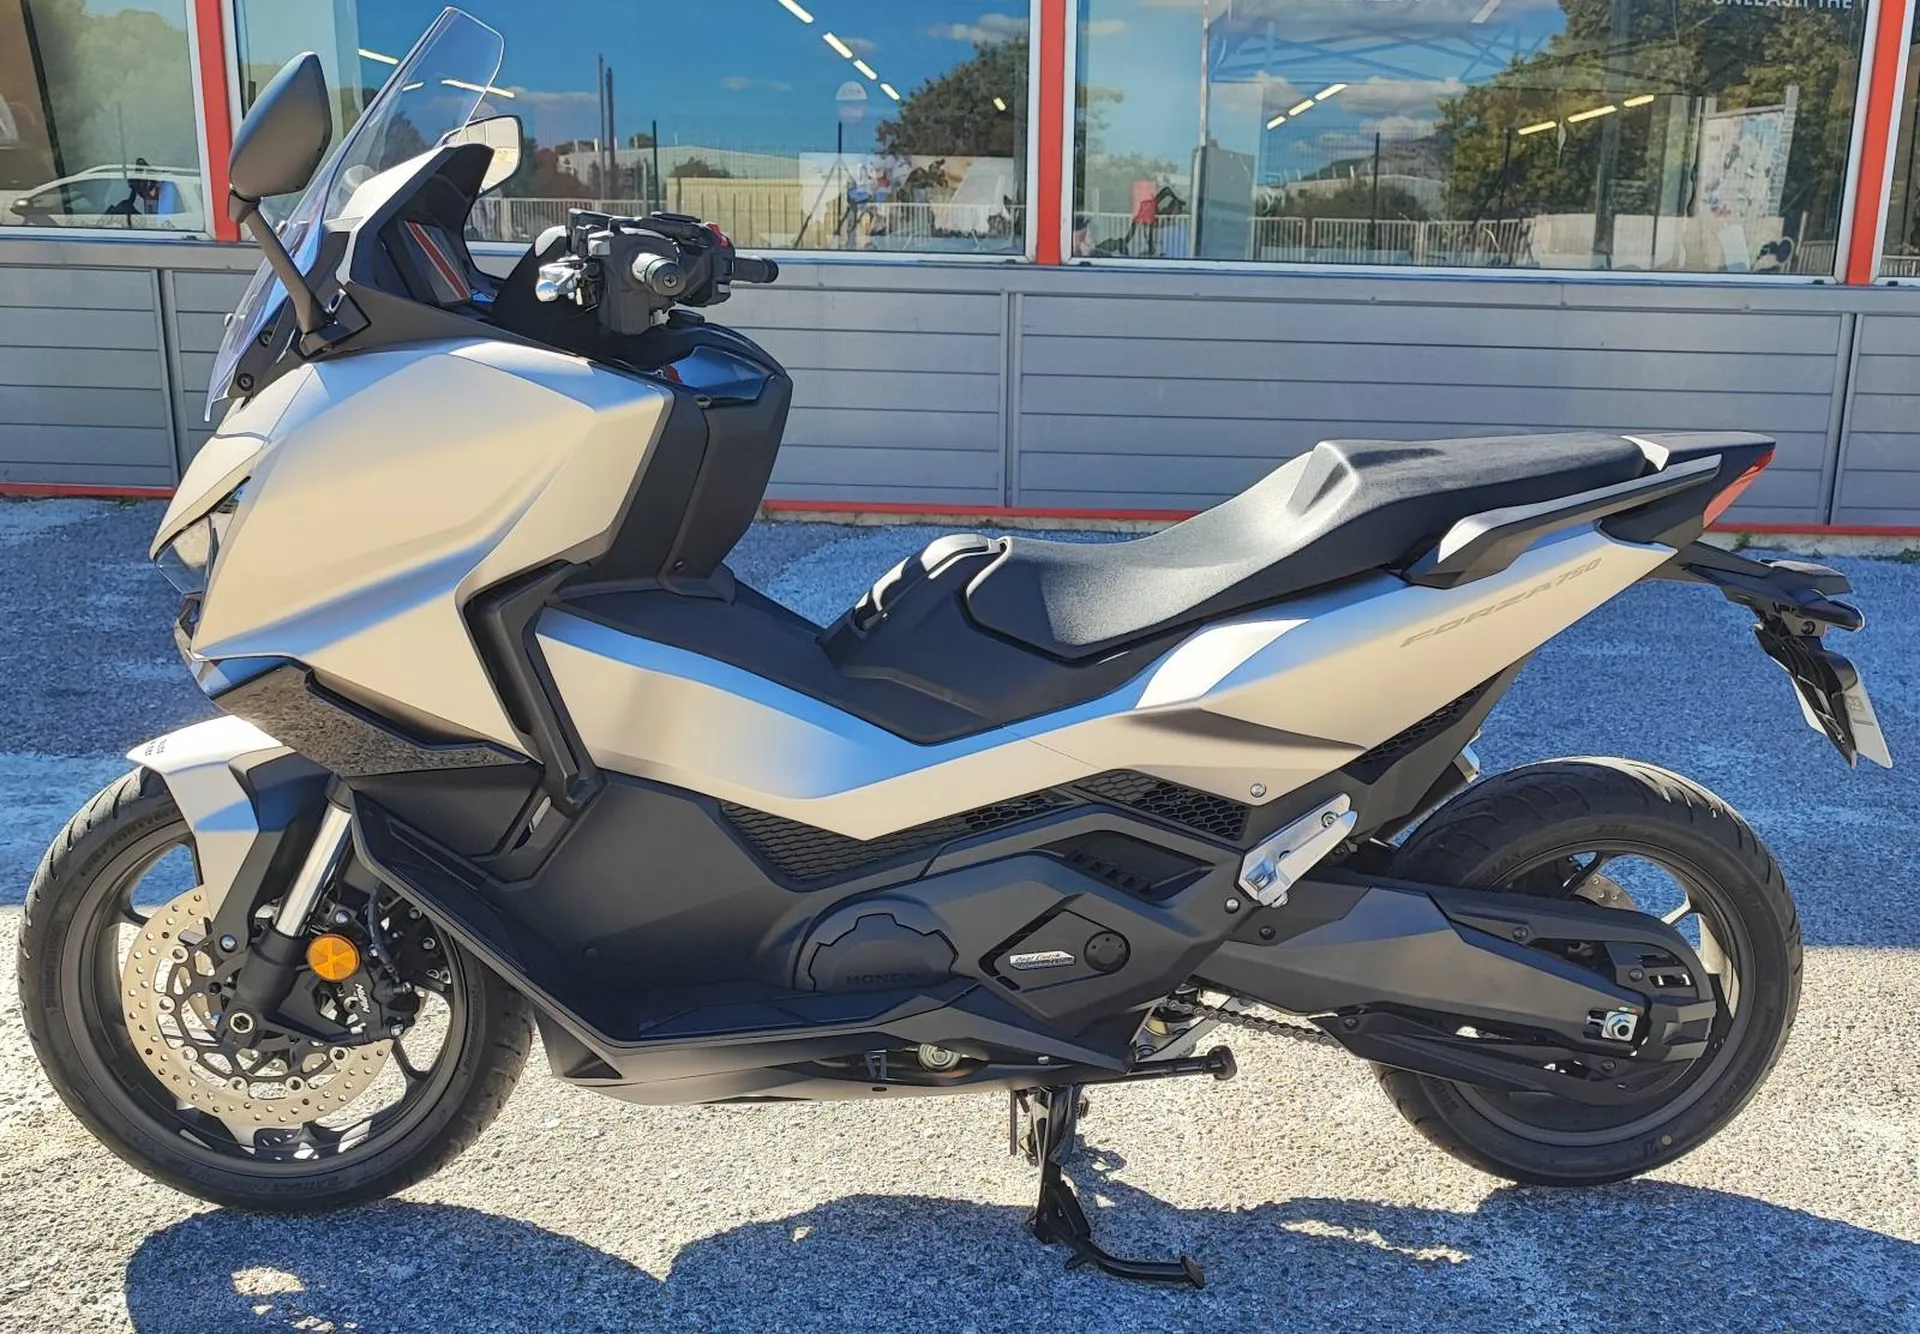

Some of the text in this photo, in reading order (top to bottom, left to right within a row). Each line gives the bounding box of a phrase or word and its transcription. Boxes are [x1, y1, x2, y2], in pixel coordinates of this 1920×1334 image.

[1400, 557, 1602, 648] FORZA 750
[846, 971, 918, 986] HONDA
